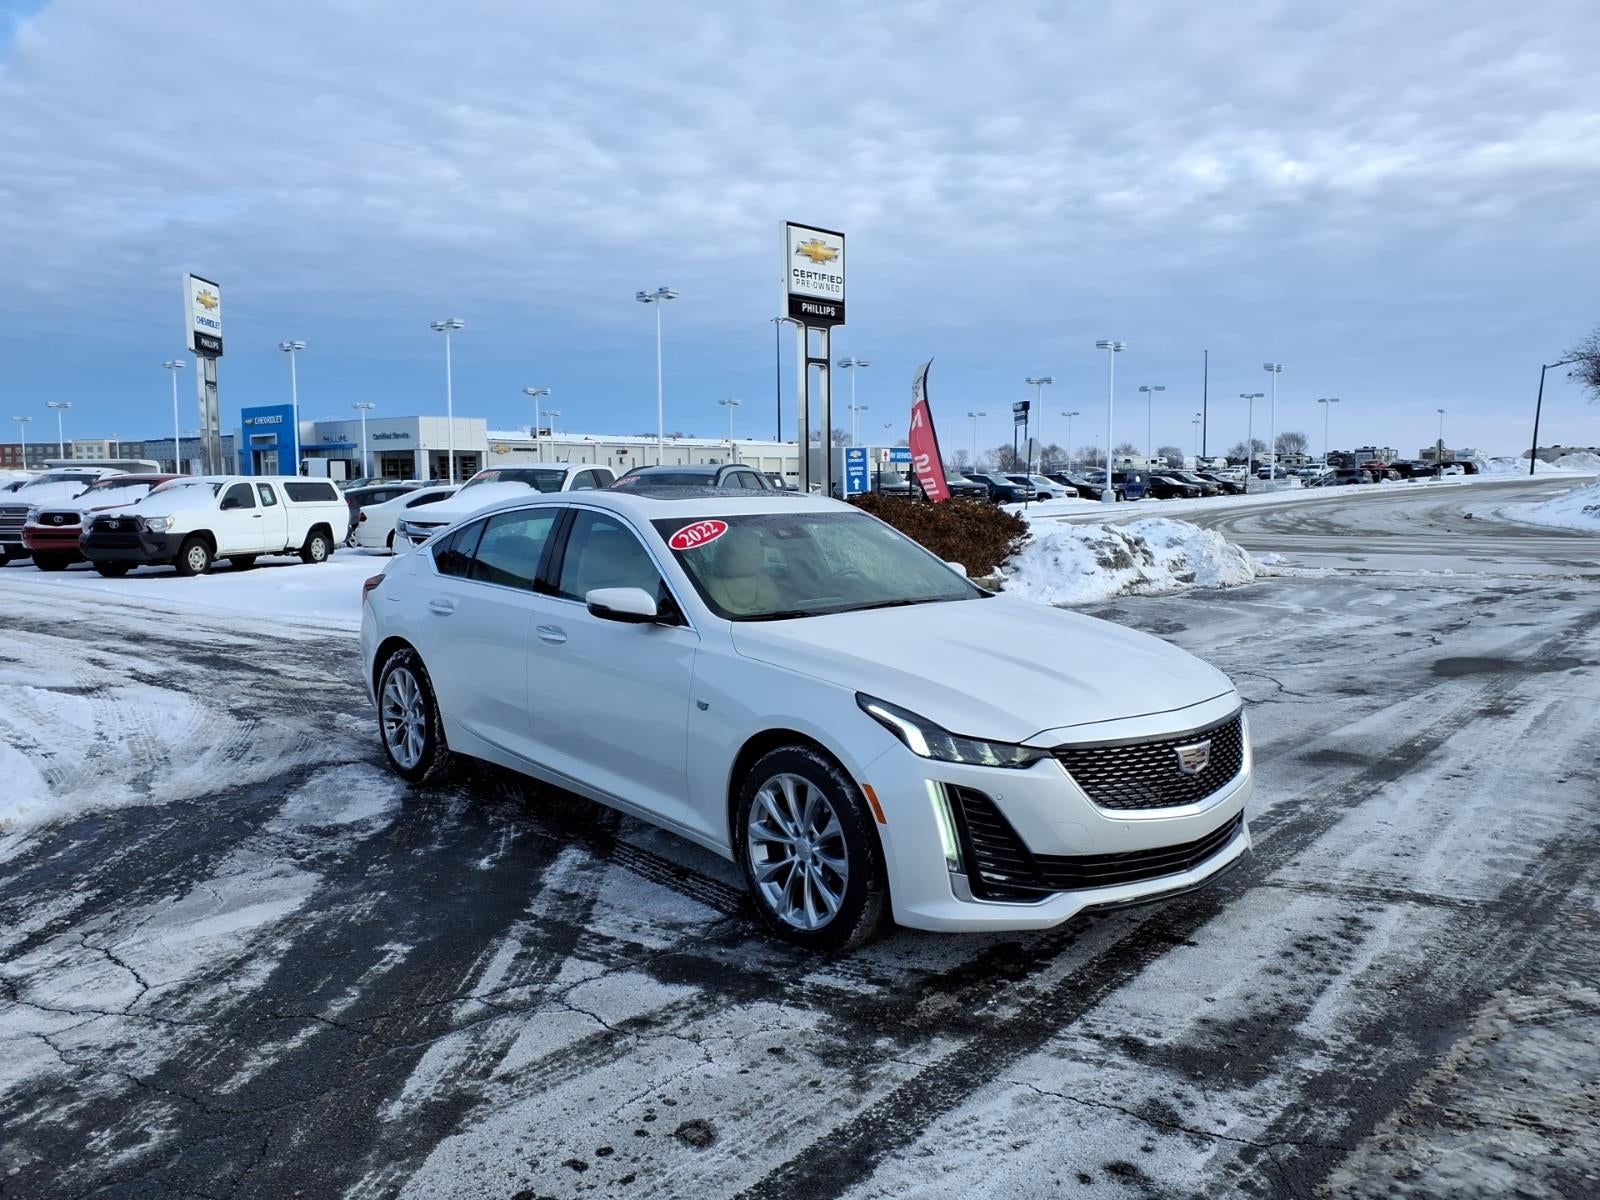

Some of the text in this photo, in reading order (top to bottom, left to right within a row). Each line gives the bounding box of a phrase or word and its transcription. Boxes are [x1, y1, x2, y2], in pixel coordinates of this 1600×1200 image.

[793, 268, 842, 285] CERTIFIED
[796, 278, 840, 293] PRE-OWNED
[801, 302, 836, 317] PHILLIPS
[196, 315, 220, 329] CHEVROLET
[201, 338, 219, 349] PHILLIPS
[254, 415, 283, 425] CHEVROLET
[678, 522, 719, 547] 2022
